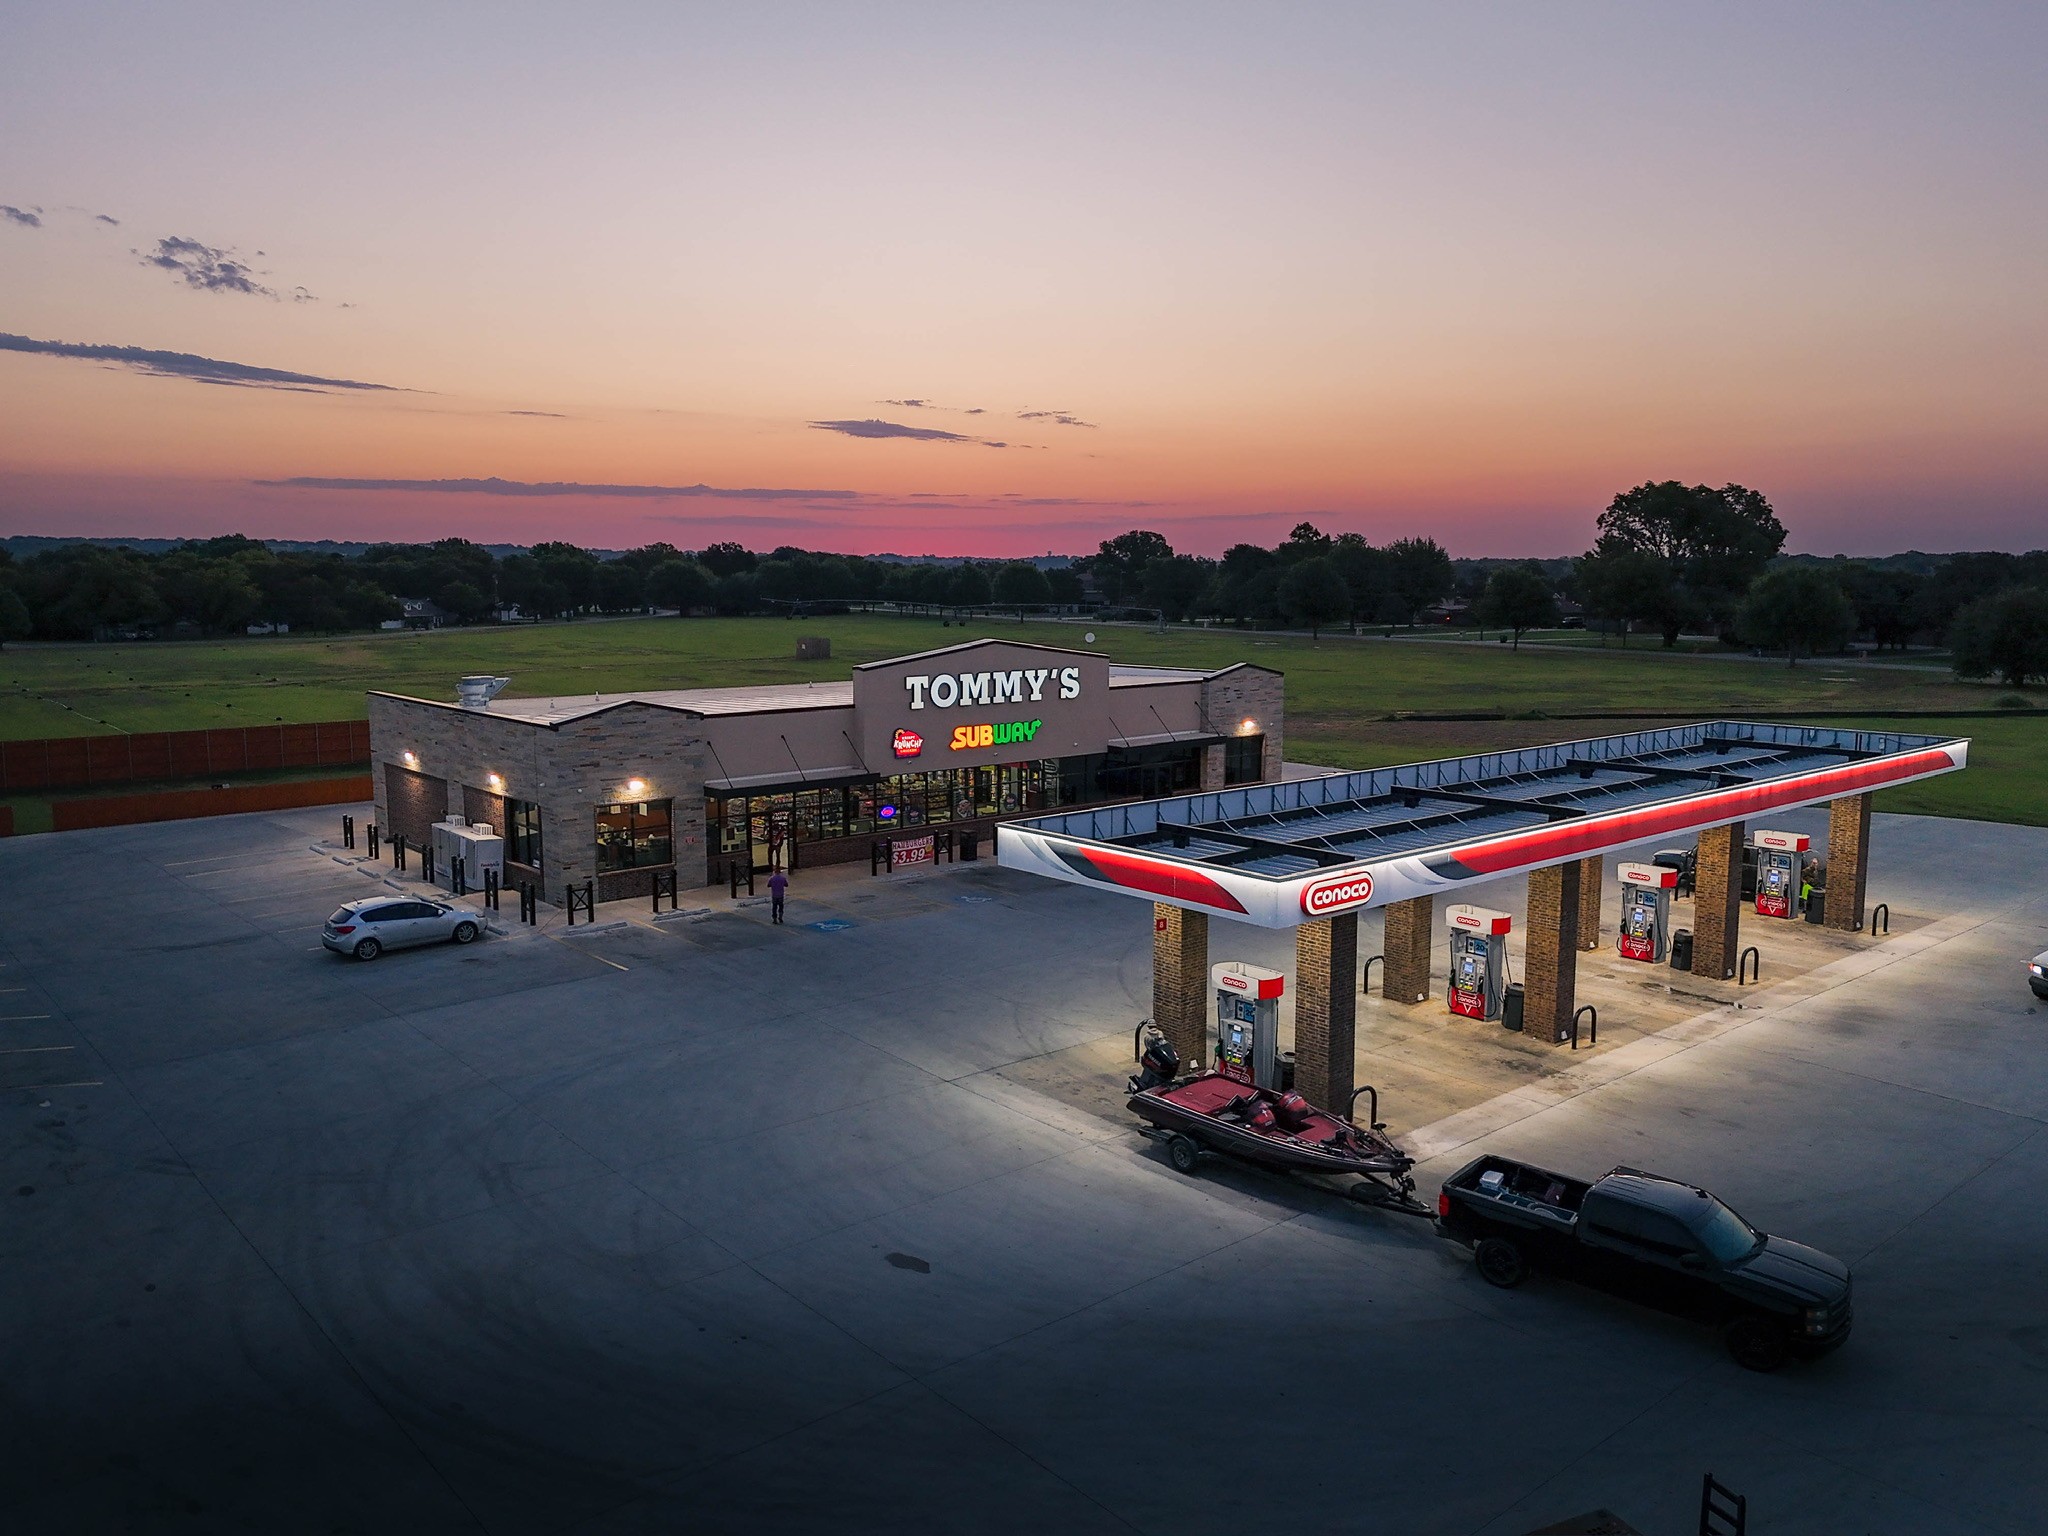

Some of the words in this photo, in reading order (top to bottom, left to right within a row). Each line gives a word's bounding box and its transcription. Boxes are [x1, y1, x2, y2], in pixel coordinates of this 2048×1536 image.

[906, 667, 1081, 709] TOMMY'S
[950, 719, 1042, 749] SUBWAY
[893, 738, 923, 749] KRUNCHY
[892, 837, 934, 849] HAMBURGERS
[892, 848, 926, 863] $3.99
